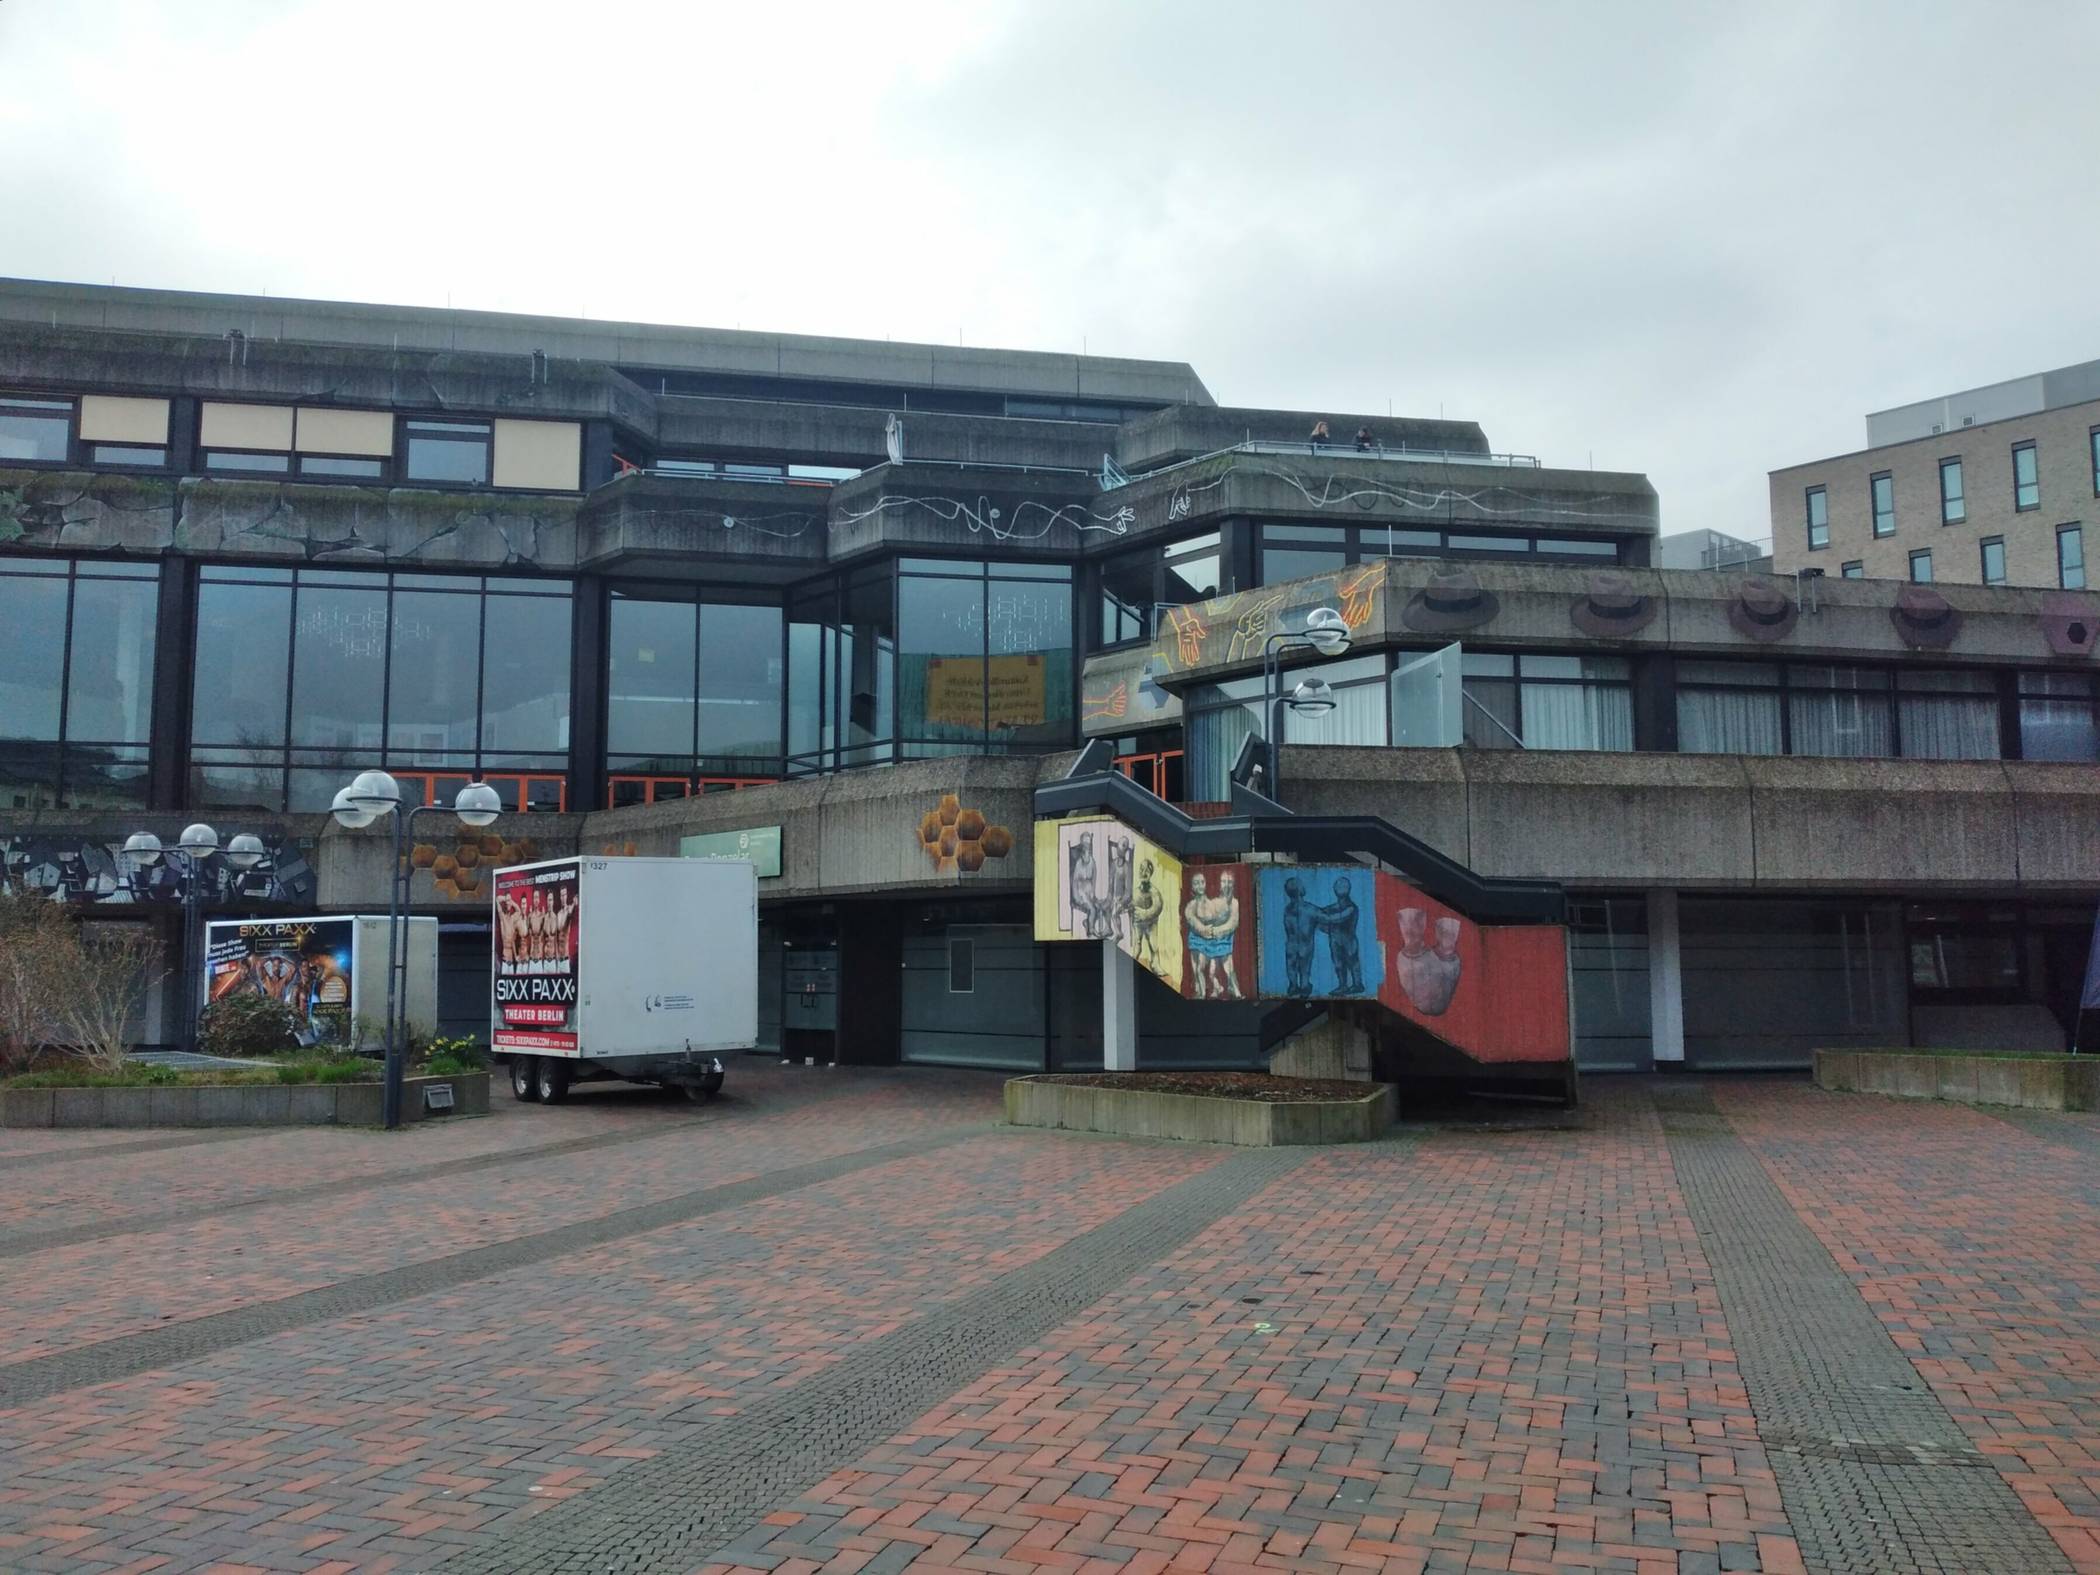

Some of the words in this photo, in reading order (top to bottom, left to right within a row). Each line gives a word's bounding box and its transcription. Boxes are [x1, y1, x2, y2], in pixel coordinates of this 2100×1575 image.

[559, 869, 576, 881] SHOW
[240, 925, 271, 937] SIXX
[275, 923, 315, 935] PAXX
[496, 979, 529, 1000] SIXX
[532, 978, 574, 1000] PAXX
[504, 1009, 535, 1021] THEATER
[538, 1010, 564, 1022] BERLIN
